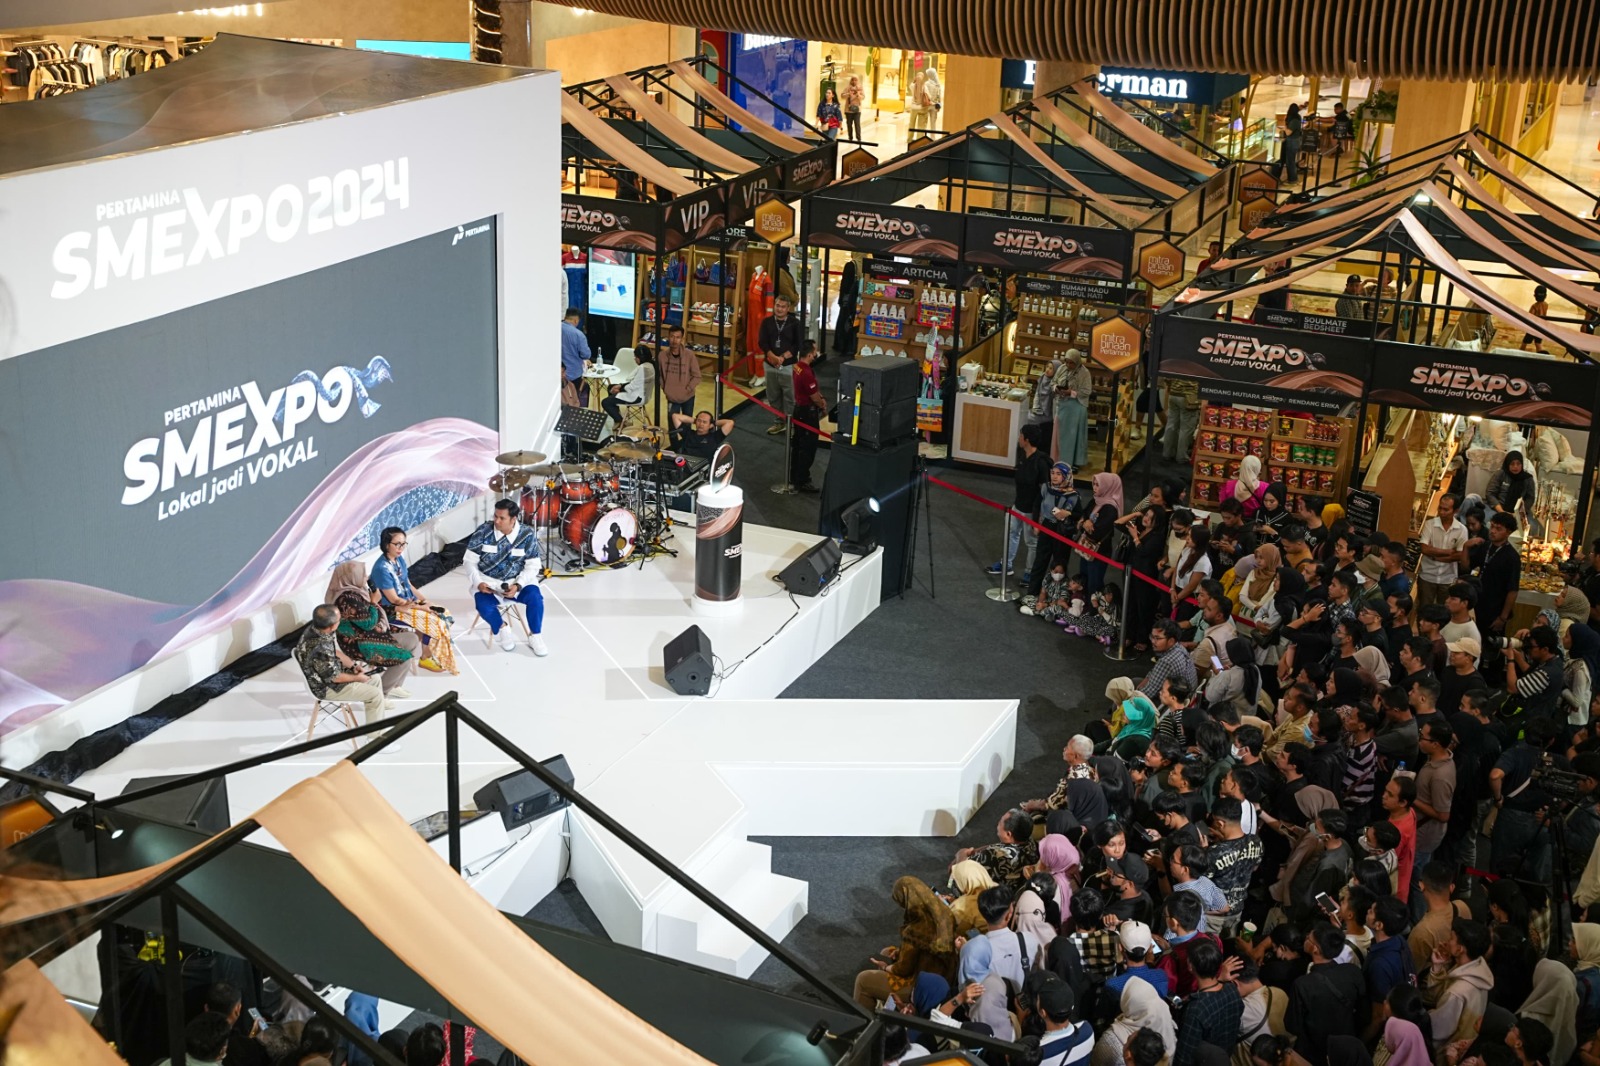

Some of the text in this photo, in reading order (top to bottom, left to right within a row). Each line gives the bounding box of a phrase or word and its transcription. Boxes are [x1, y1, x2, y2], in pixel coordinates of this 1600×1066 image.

[743, 178, 768, 209] VIP
[96, 189, 180, 220] PERTAMINA
[680, 200, 710, 233] VIP
[50, 157, 410, 299] SMEXPO 2024
[465, 224, 490, 237] PERTAMINA
[577, 224, 602, 233] VOKAL
[836, 213, 915, 236] SMEXPO
[873, 233, 900, 241] VOKAL
[993, 231, 1078, 254] SMEXPO
[1033, 251, 1061, 260] VOKAL
[1148, 256, 1170, 264] mitra
[902, 267, 948, 280] ARTICHA
[1060, 289, 1086, 298] SIMPUL
[1061, 283, 1087, 292] RUMAH
[1087, 287, 1109, 295] MADU
[1303, 322, 1346, 334] BEDSHEET
[1304, 316, 1347, 328] SOULMATE
[1100, 333, 1126, 344] mitra
[1217, 332, 1251, 342] PERTAMINA
[1100, 340, 1131, 351] binaan
[1197, 336, 1305, 366] SMEXPO
[1100, 349, 1131, 357] Pertamina
[1209, 356, 1283, 372] Lokal jadi VOKAL
[1432, 362, 1469, 372] PERTAMINA
[1410, 366, 1528, 396] SMEXPO
[1201, 387, 1232, 396] RENDANG
[1232, 391, 1260, 400] MUTIARA
[1288, 398, 1320, 407] RENDANG
[1320, 402, 1340, 410] ERIKA
[1423, 386, 1503, 403] Lokal jadi VOKAL
[164, 386, 241, 426] PERTAMINA
[121, 366, 352, 505] SMEXPO
[158, 436, 318, 520] Lokal jadi VOKAL
